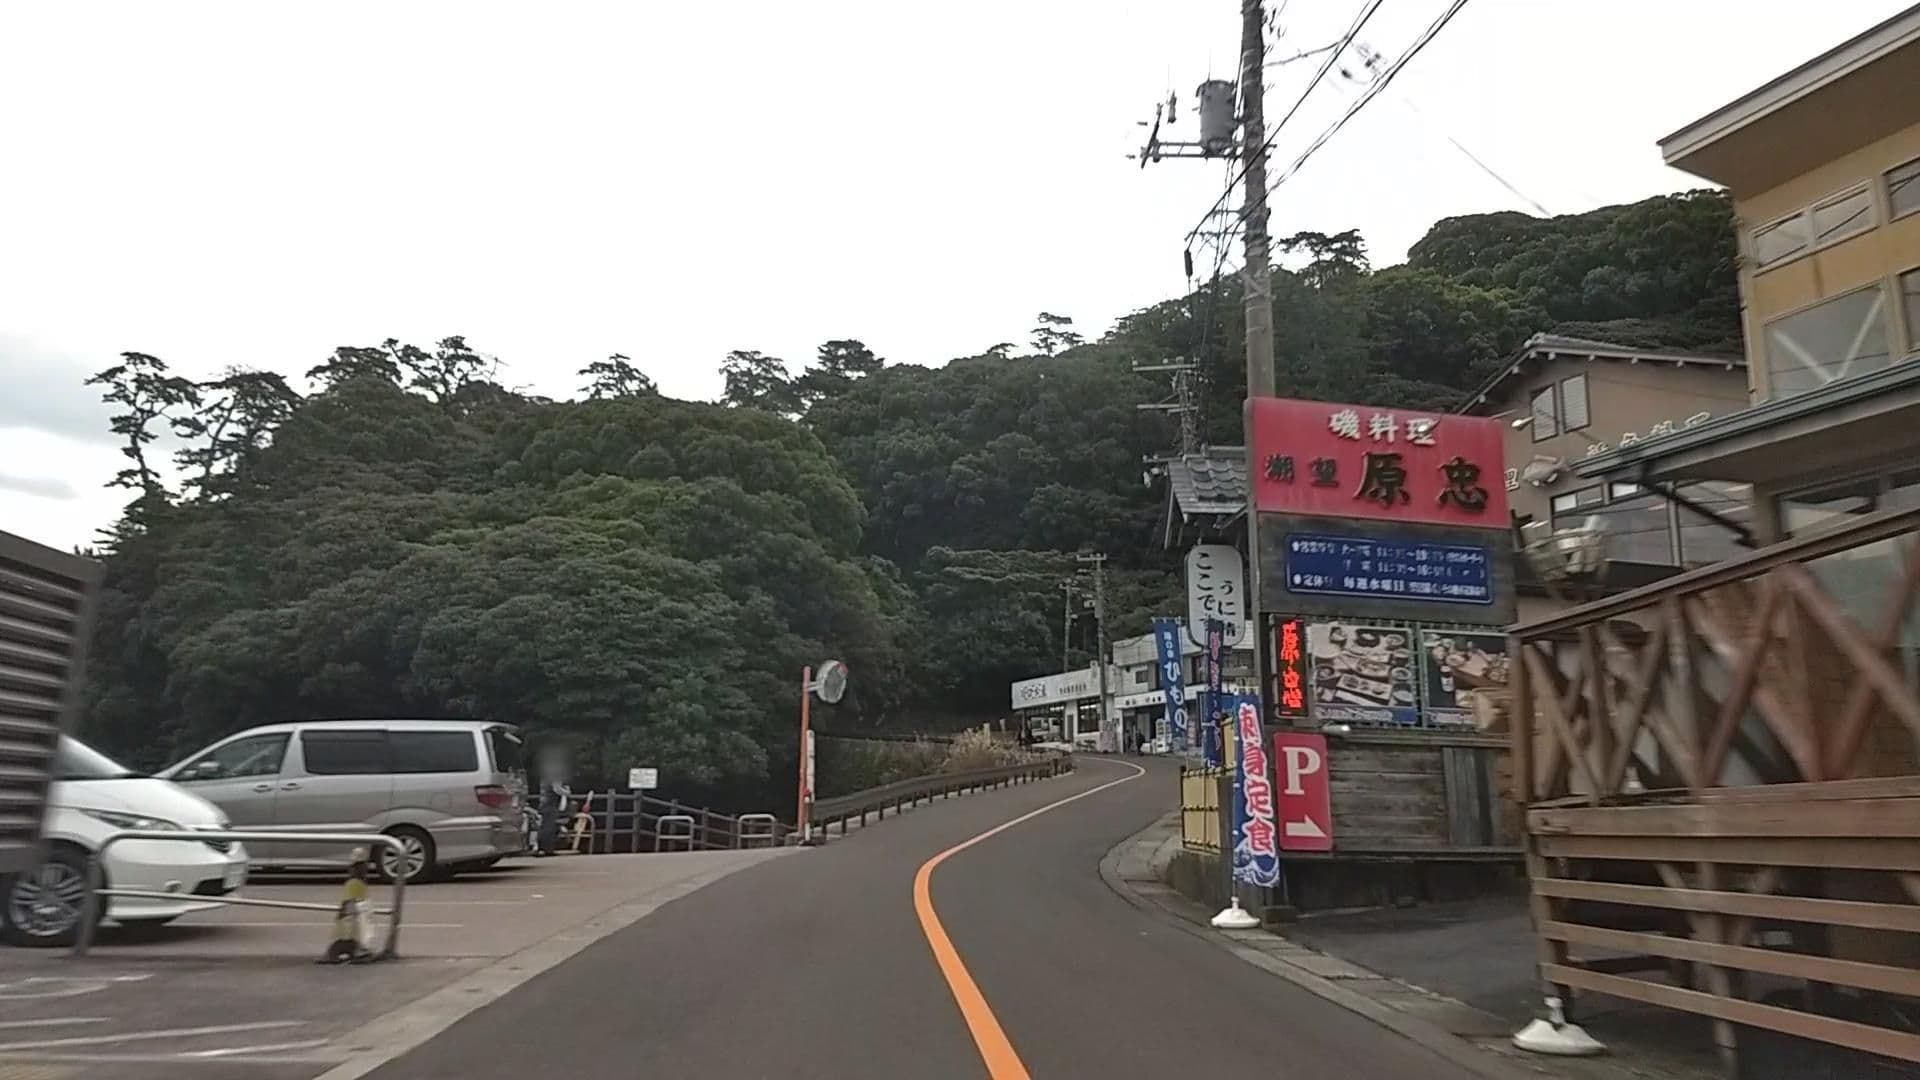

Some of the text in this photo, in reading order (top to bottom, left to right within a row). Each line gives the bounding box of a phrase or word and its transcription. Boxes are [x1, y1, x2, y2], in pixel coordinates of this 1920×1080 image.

[1328, 408, 1440, 445] 磯料理
[1353, 451, 1489, 513] 原忠
[1164, 661, 1188, 730] ひもの
[1283, 746, 1321, 795] P
